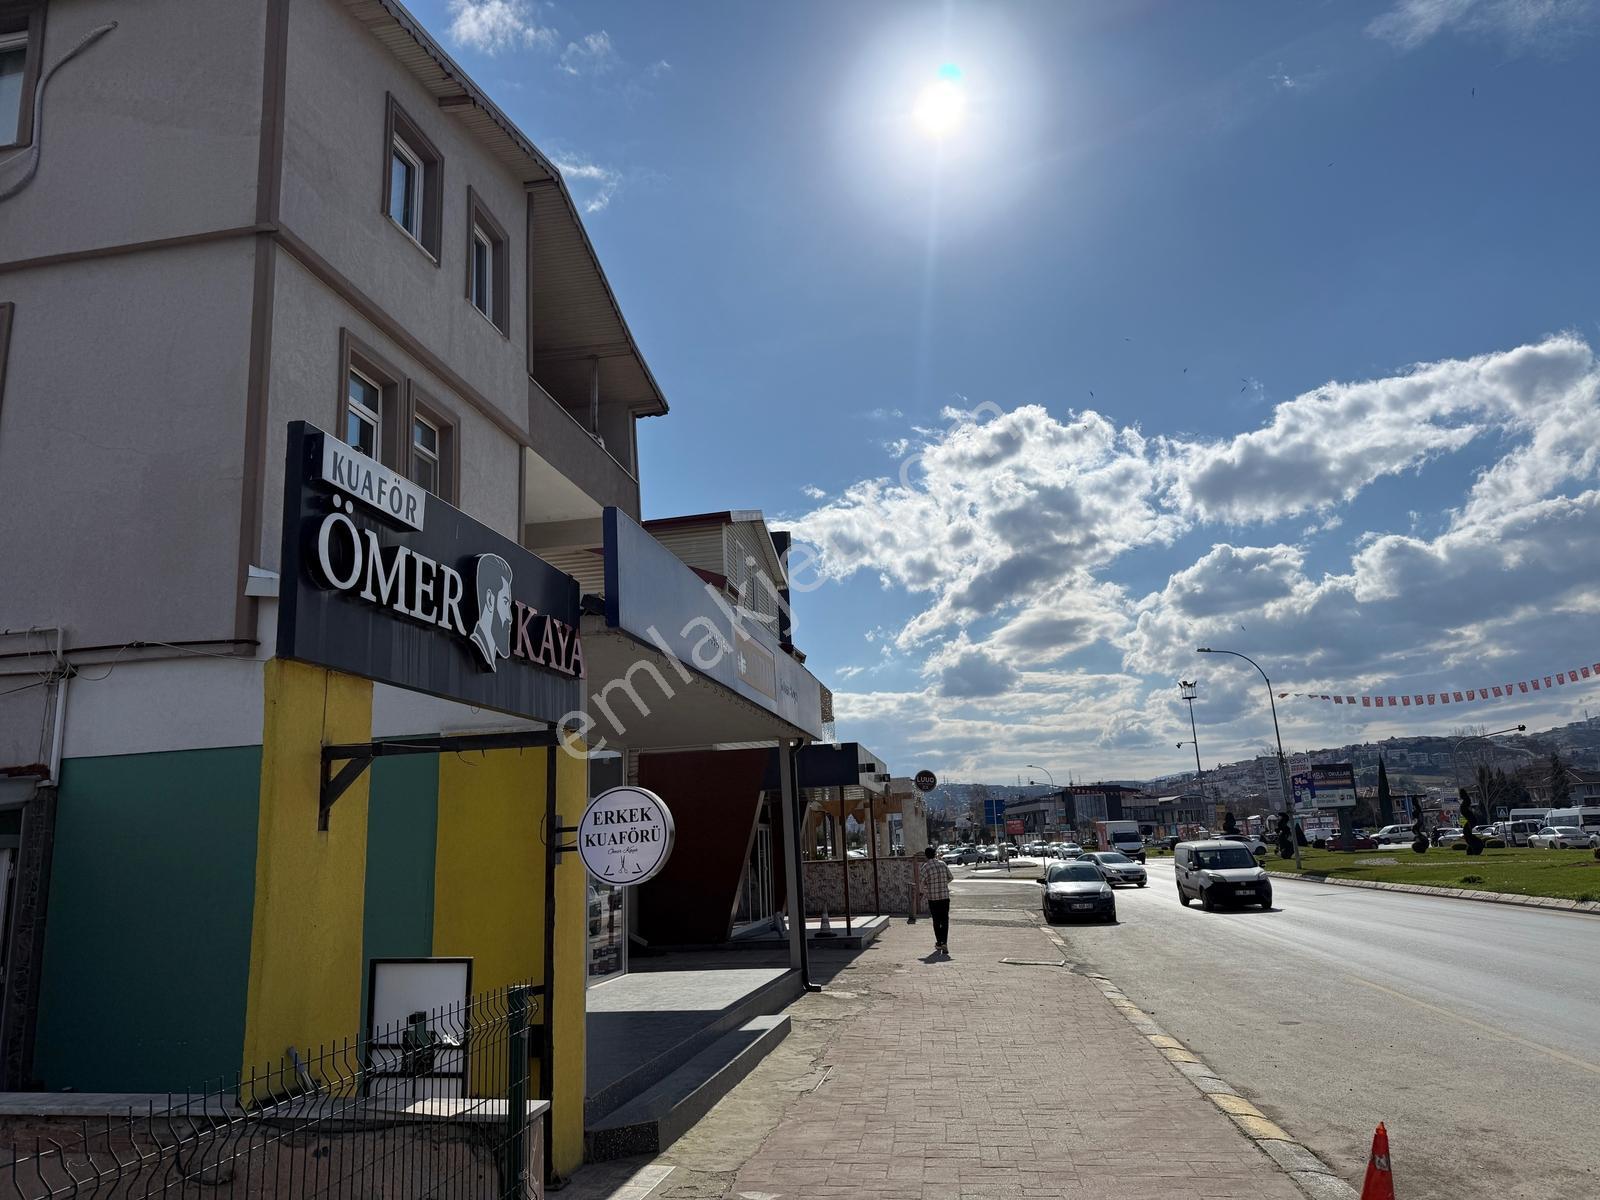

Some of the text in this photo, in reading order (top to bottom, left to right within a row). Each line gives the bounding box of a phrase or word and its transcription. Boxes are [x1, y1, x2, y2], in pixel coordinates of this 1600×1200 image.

[331, 450, 418, 524] KUAFÖR
[317, 494, 586, 679] ÖMER KAYA
[585, 825, 661, 848] KUAFÖRÜ
[593, 807, 652, 826] ERKEK
